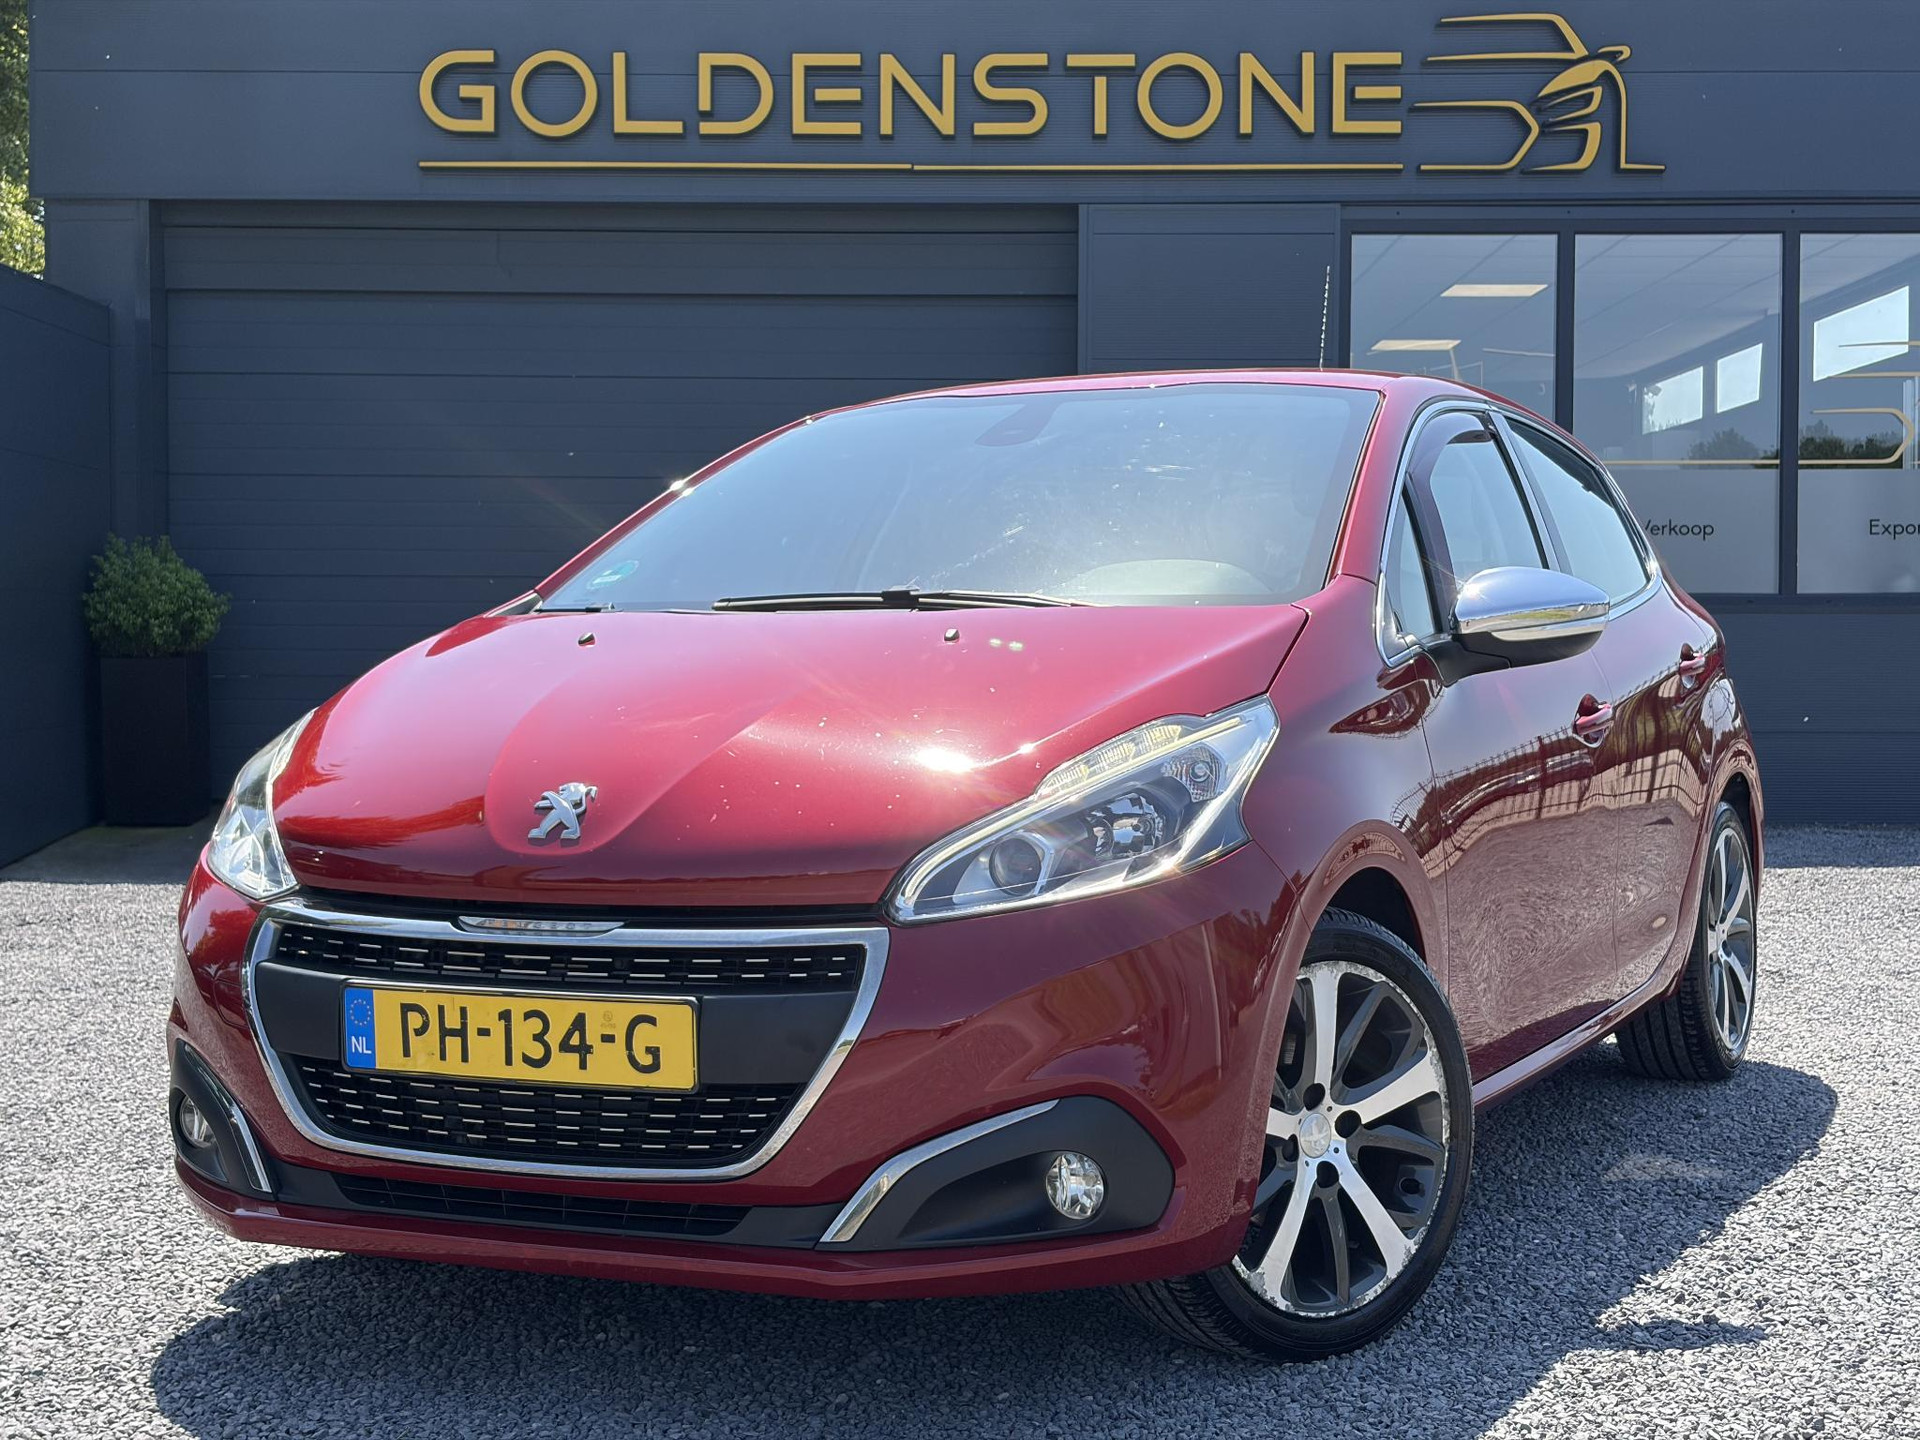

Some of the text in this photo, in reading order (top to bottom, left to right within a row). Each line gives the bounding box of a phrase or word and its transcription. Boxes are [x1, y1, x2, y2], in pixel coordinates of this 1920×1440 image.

[419, 50, 1403, 139] GOLDENSTONE
[351, 1036, 372, 1054] NL
[400, 1003, 661, 1074] PH-134-G
